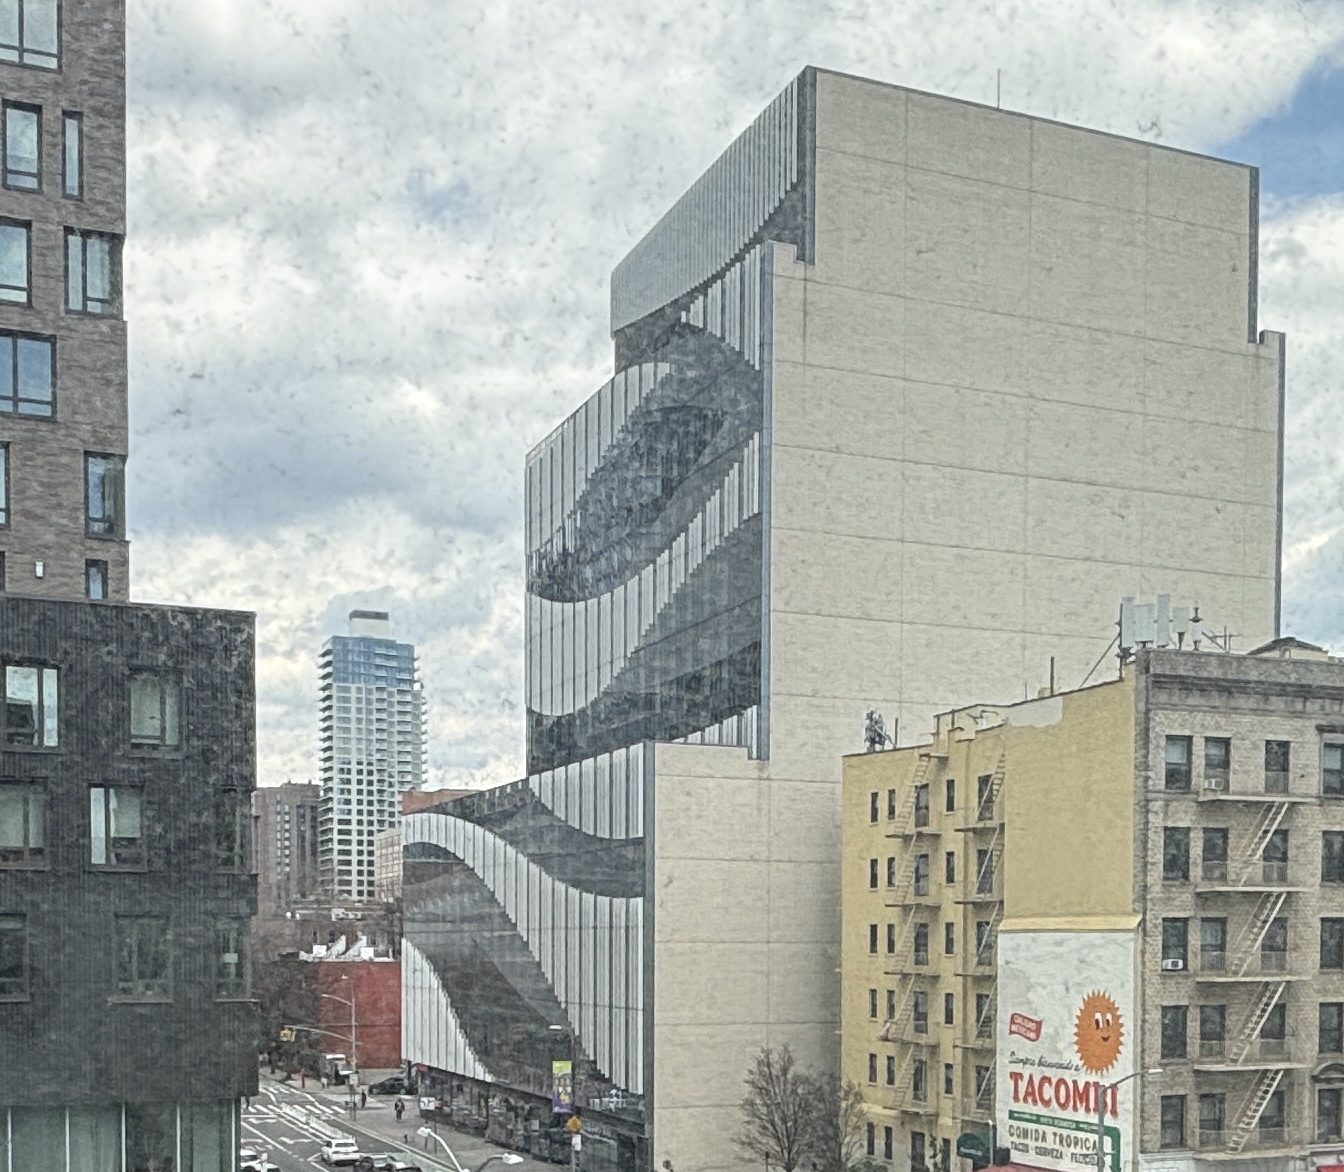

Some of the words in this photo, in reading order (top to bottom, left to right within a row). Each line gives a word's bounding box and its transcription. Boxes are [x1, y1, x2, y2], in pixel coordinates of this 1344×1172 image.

[1008, 1124, 1047, 1144] COMIDA
[1052, 1132, 1098, 1152] TROPICA
[1035, 1145, 1063, 1160] CERVEZA
